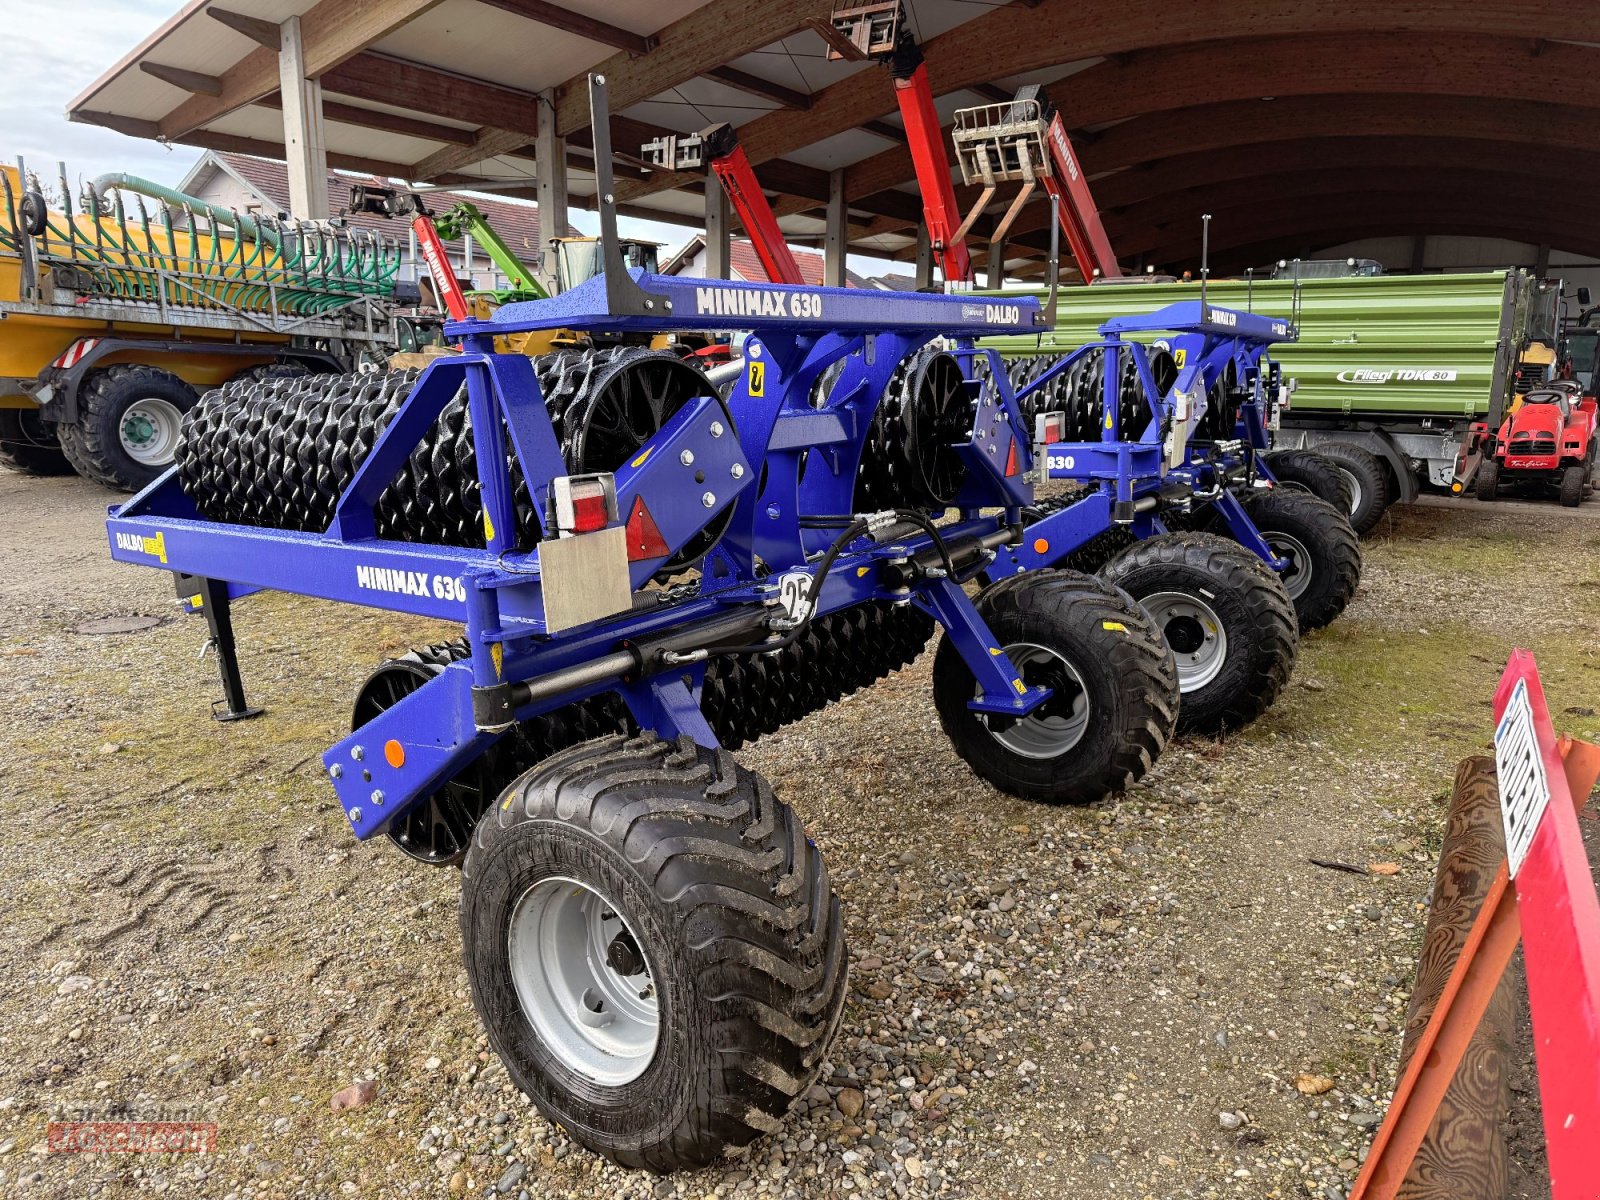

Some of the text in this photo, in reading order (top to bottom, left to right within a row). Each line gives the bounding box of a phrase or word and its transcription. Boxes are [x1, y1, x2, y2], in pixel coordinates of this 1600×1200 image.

[1054, 121, 1078, 181] MANITOU
[422, 240, 451, 294] MANITOU
[696, 287, 822, 318] MINIMAX 630
[986, 304, 1019, 325] DALBO
[1353, 369, 1449, 383] Fliegl TDK 80
[116, 532, 144, 553] DALBO
[356, 565, 467, 603] MINIMAX 630
[1499, 701, 1539, 854] KUNDEN
